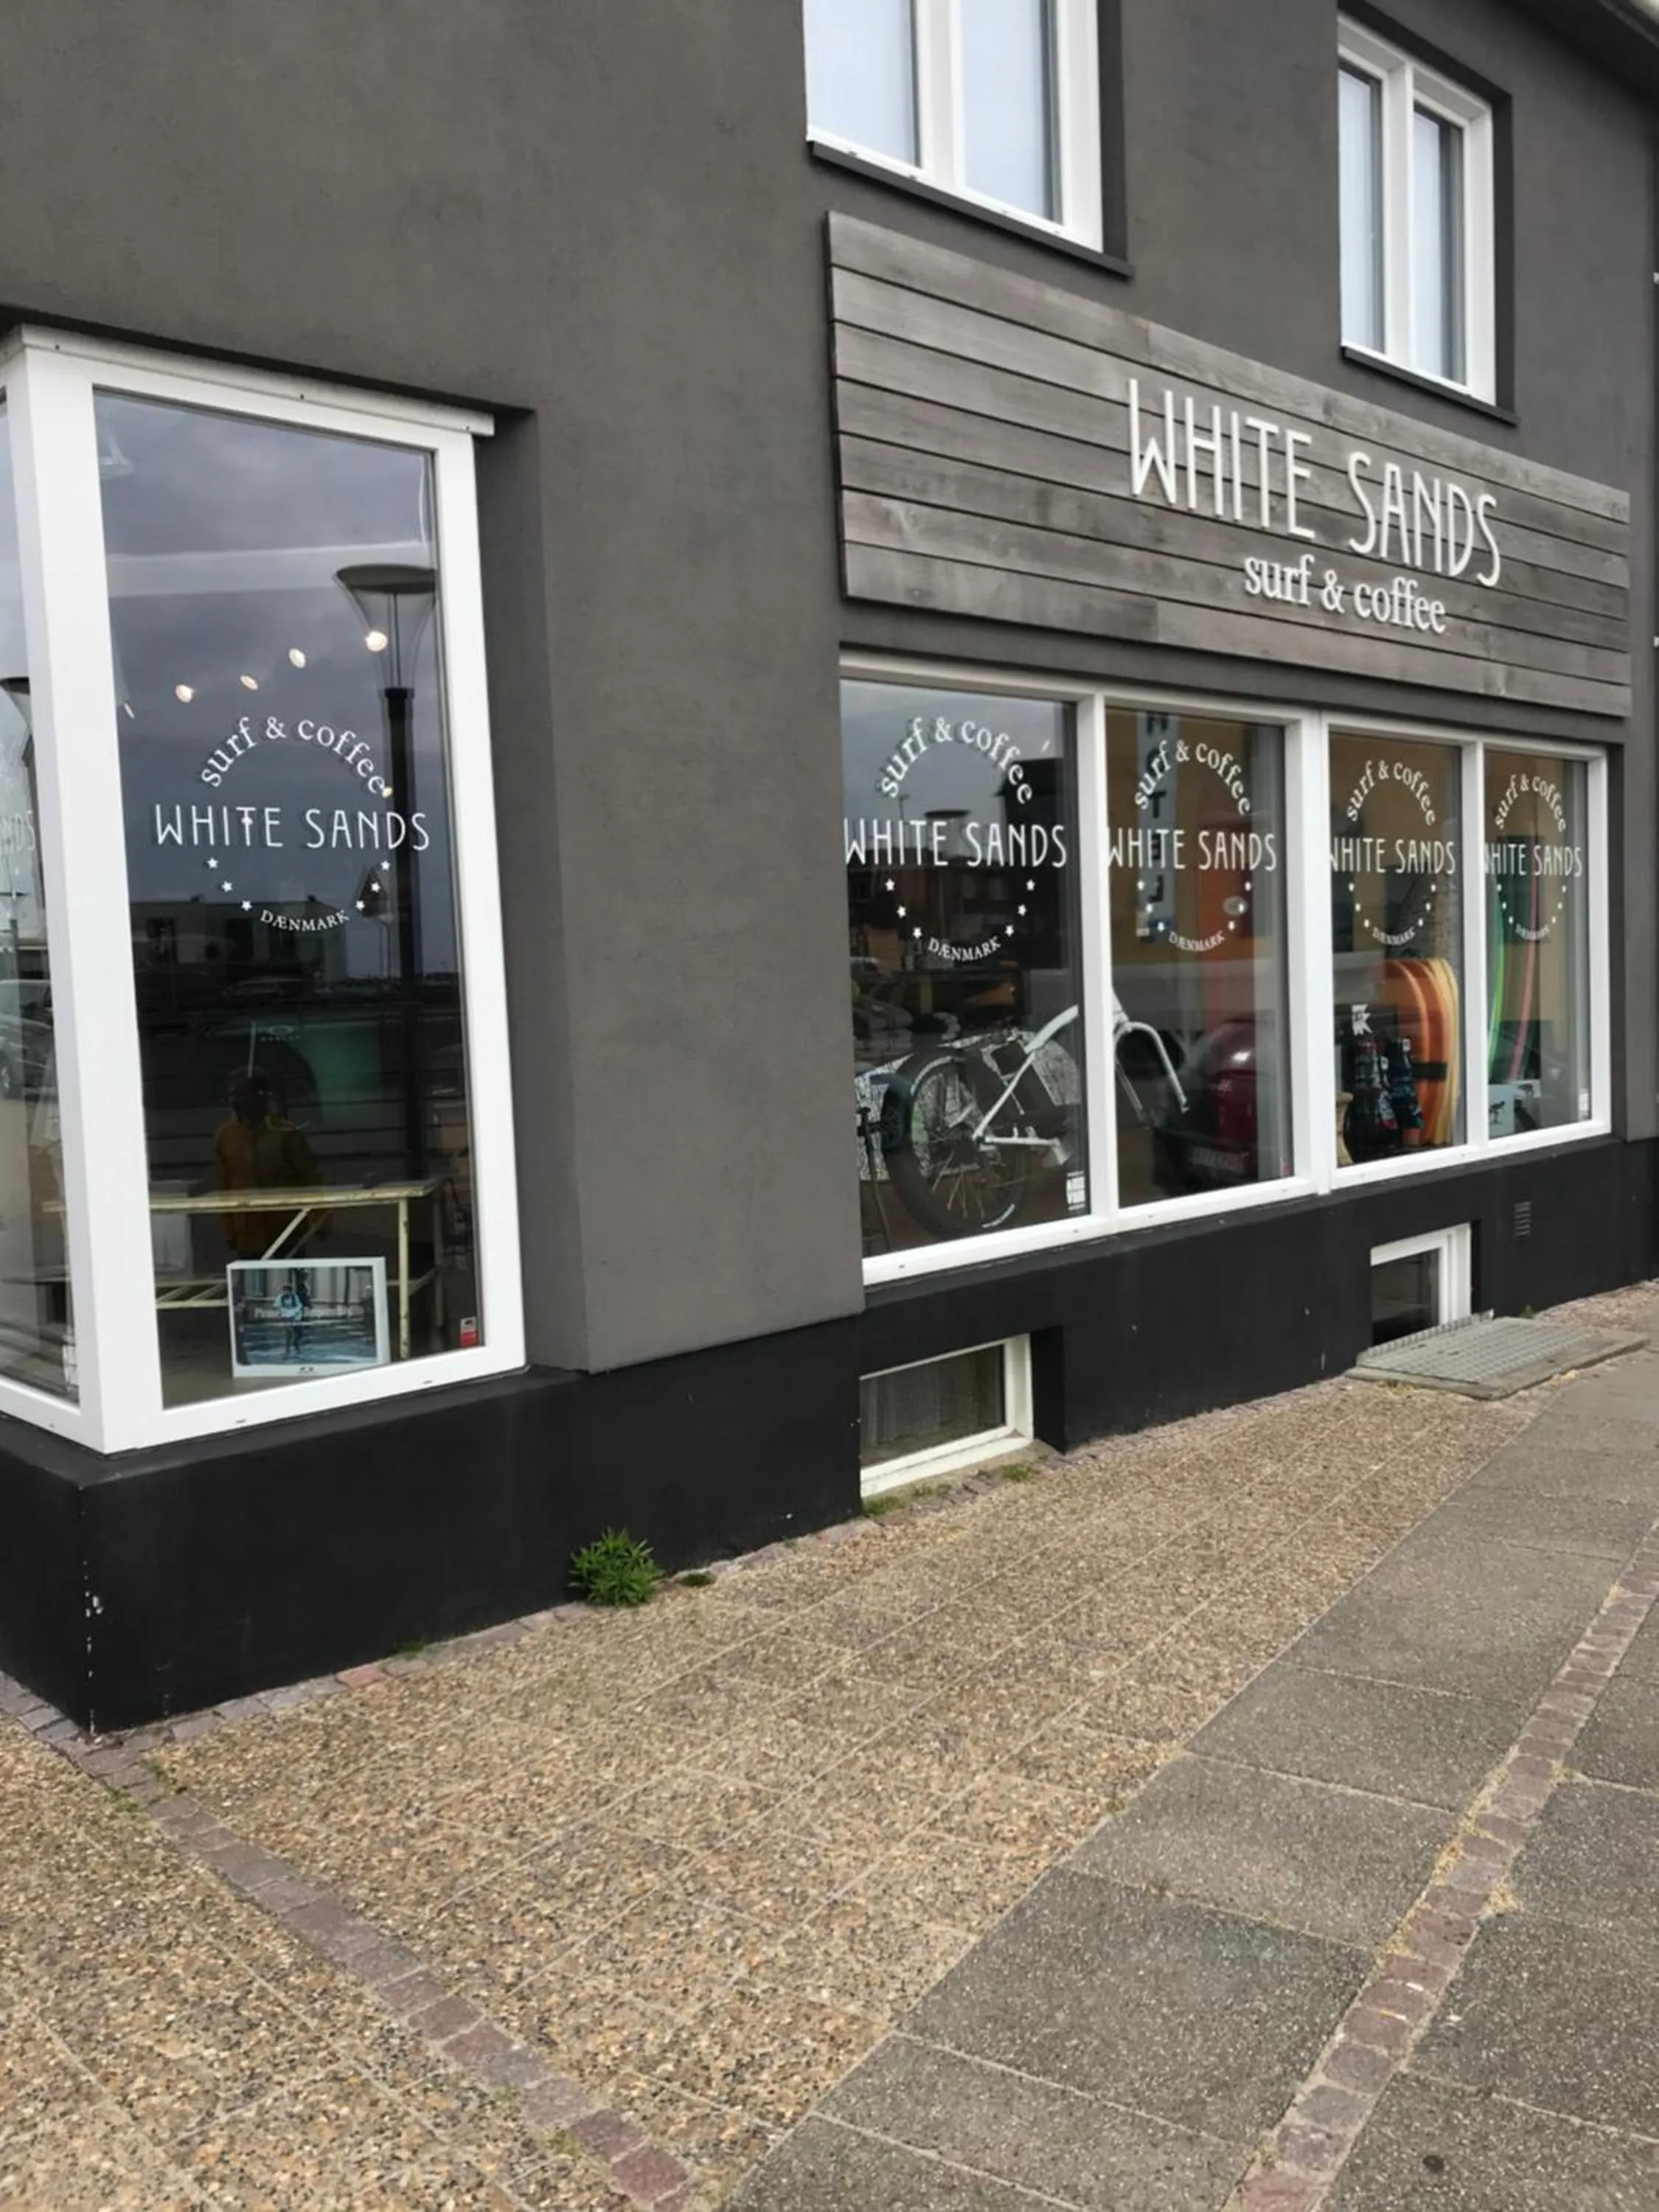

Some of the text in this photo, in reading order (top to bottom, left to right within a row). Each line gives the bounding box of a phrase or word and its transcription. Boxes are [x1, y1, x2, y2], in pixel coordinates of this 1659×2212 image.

[1129, 378, 1501, 587] WHITE SANDS
[1244, 553, 1447, 634] surf & coffee
[201, 716, 386, 796] surf & coffee
[881, 716, 1033, 806] surf & coffee
[1134, 739, 1251, 815] surf & coffee
[1346, 759, 1436, 827] surf & coffee
[1494, 774, 1519, 830] surf
[1531, 776, 1567, 833] coffee
[155, 804, 431, 852] WHITE SANDS
[844, 818, 1068, 868] WHITE SANDS
[1107, 827, 1277, 872] WHITE SANDS
[1395, 839, 1456, 876] SANDS
[1533, 844, 1583, 878] SANDS
[260, 908, 351, 933] DÆNMARK
[927, 936, 1002, 962] DÆNMARK
